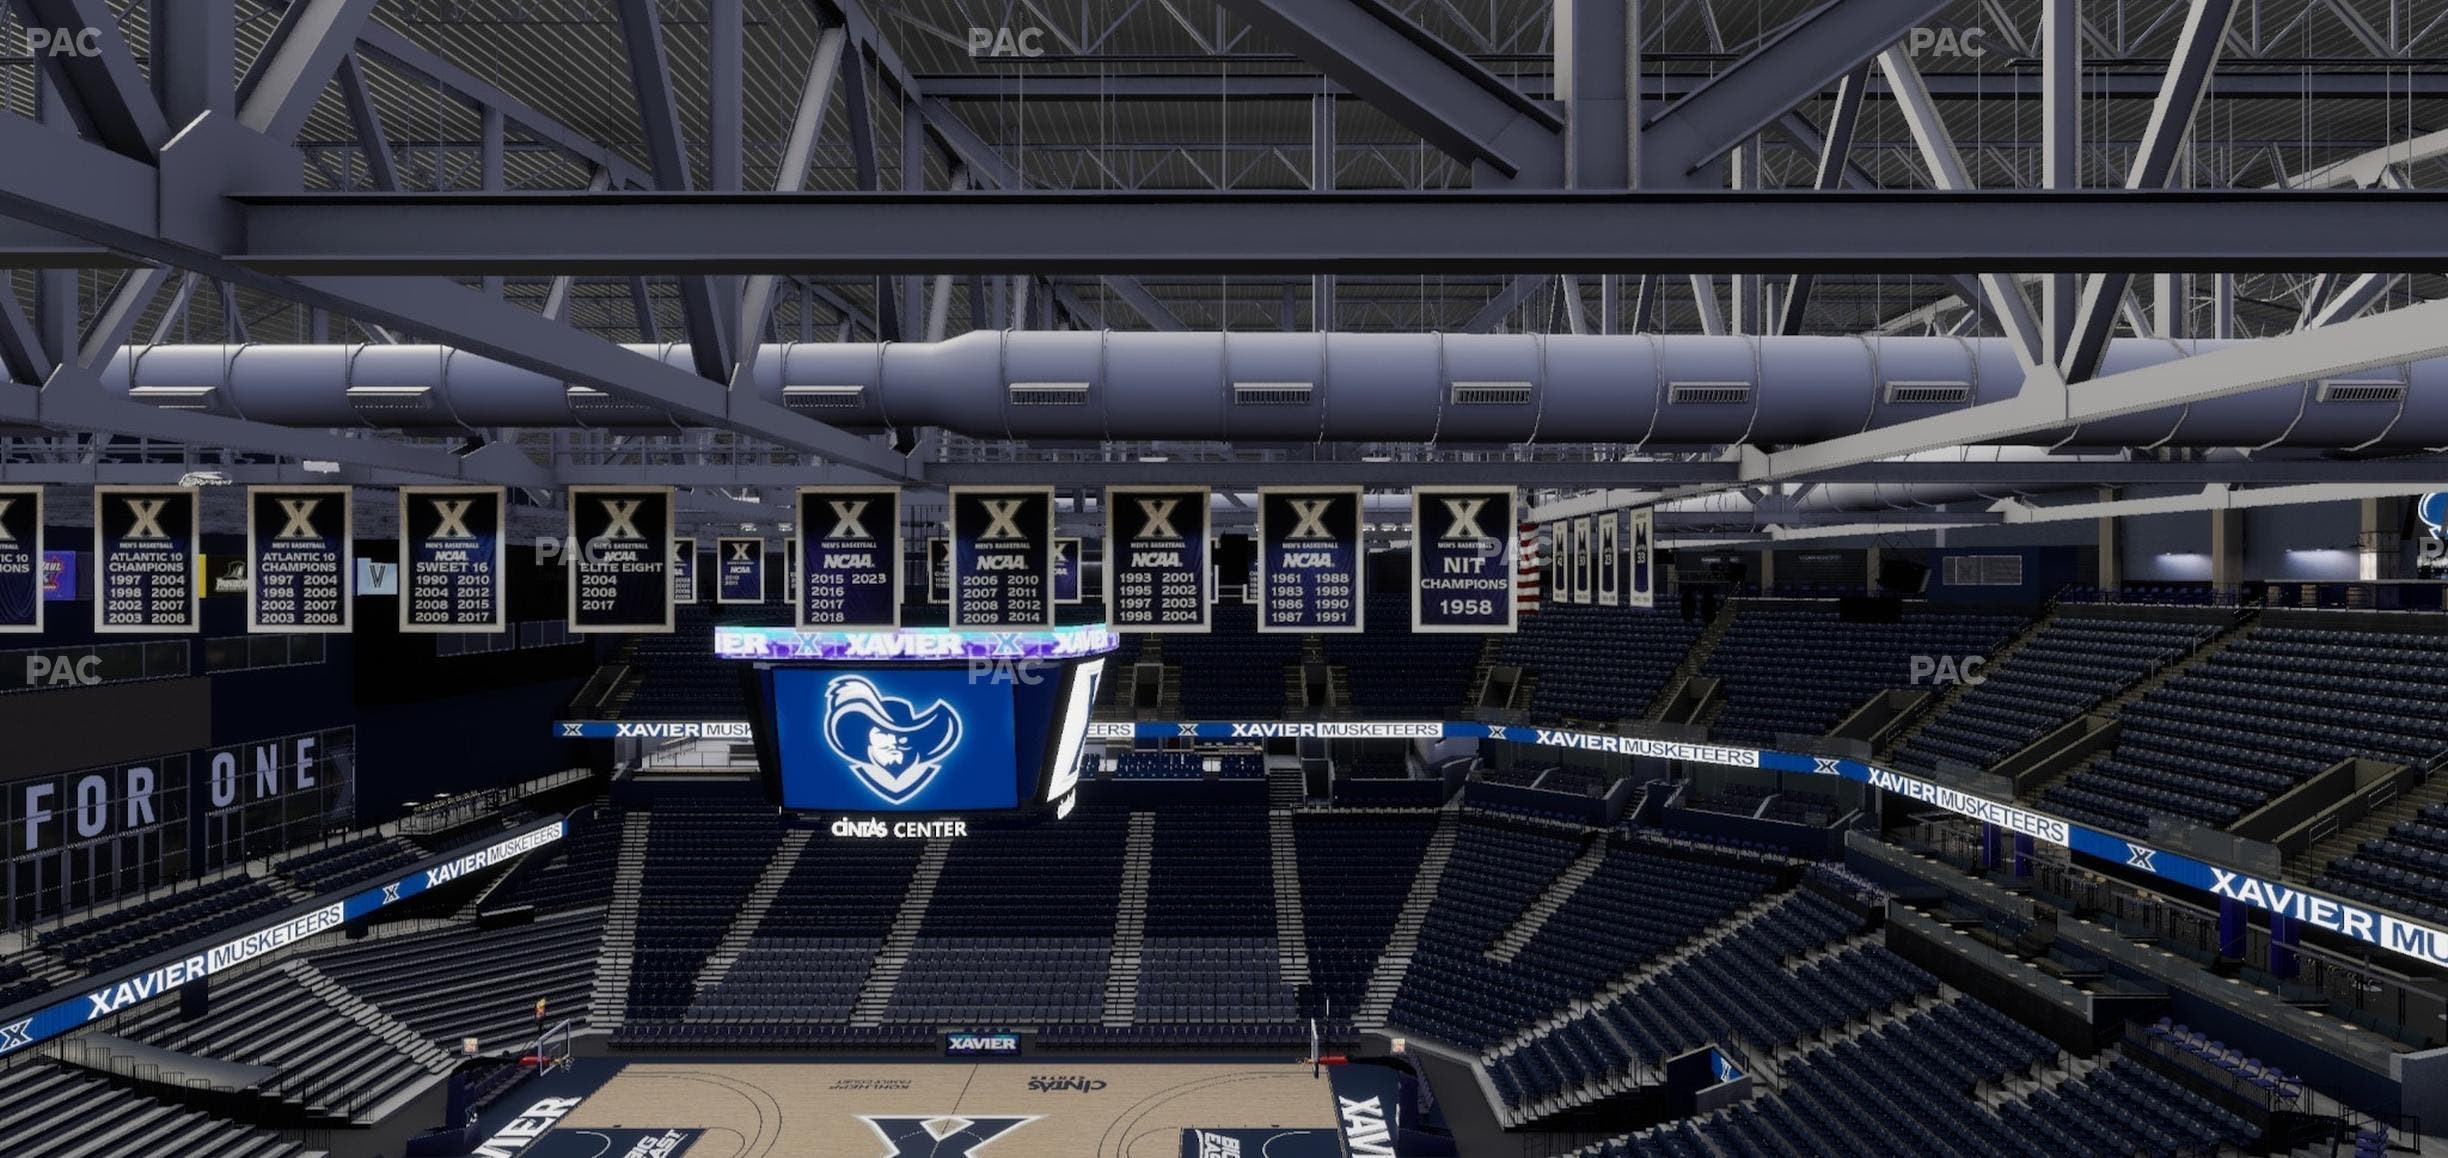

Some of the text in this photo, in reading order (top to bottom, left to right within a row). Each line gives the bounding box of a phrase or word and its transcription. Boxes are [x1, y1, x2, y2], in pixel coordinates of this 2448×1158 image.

[123, 500, 169, 539] X
[275, 500, 322, 539] X
[428, 501, 476, 540] X
[597, 501, 645, 540] X
[825, 502, 869, 539] X
[978, 500, 1022, 539] X
[1135, 500, 1182, 539] X
[1287, 500, 1334, 539] X
[1440, 500, 1491, 539] X
[16, 554, 28, 562] 10
[110, 553, 183, 561] ATLANTIC 10
[263, 553, 335, 561] ATLANTIC 10
[435, 551, 468, 563] NCAA
[602, 551, 637, 563] NCAA
[109, 563, 183, 572] CHAMPIONS
[262, 563, 336, 572] CHAMPIONS
[417, 562, 488, 572] SWEET 16
[579, 561, 619, 572] ELITE
[623, 563, 663, 572] EIGHT
[1444, 558, 1485, 573] NIT
[111, 575, 184, 585] 1997 2004
[263, 575, 337, 585] 1997 2004
[417, 575, 489, 585] 1990 2010
[583, 575, 617, 585] 2004
[812, 574, 886, 584] 2015 2023
[963, 575, 1039, 585] 2006 2010
[1120, 573, 1193, 583] 1993 2001
[1272, 573, 1349, 583] 1961 1988
[1419, 579, 1509, 590] CHAMPIONS
[111, 588, 184, 597] 1998 2006
[263, 588, 337, 597] 1998 2006
[415, 588, 489, 597] 2004 2012
[582, 588, 616, 597] 2008
[812, 586, 844, 596] 2016
[963, 587, 1036, 598] 2007 2011
[1120, 585, 1196, 595] 1995 2002
[1272, 586, 1349, 596] 1983 1989
[109, 600, 184, 610] 2002 2007
[262, 600, 336, 610] 2002 2007
[416, 599, 489, 609] 2008 2015
[583, 600, 614, 610] 2017
[812, 599, 844, 609] 2017
[963, 600, 1040, 611] 2008 2012
[1120, 598, 1197, 608] 1997 2003
[1272, 599, 1349, 609] 1986 1990
[1441, 600, 1492, 614] 1958
[109, 613, 185, 623] 2003 2008
[262, 613, 337, 623] 2003 2008
[416, 612, 489, 622] 2009 2017
[812, 612, 844, 622] 2018
[964, 612, 1040, 623] 2009 2014
[1120, 611, 1197, 621] 1998 2004
[1272, 612, 1346, 622] 1987 1991
[846, 633, 964, 655] XAVIER
[616, 724, 699, 736] XAVIER
[1231, 724, 1315, 736] XAVIER
[1322, 724, 1438, 735] MUSKETEERS
[1536, 731, 1618, 752] XAVIER
[1624, 740, 1755, 766] MUSKETEERS
[26, 737, 315, 850] FOR ONE
[1868, 768, 1936, 801] XAVIER
[1941, 790, 2065, 841] MUSKETEERS
[894, 821, 968, 836] CENTER
[426, 852, 486, 888] XAVIER
[491, 823, 560, 861] MUSKETEERS
[2210, 867, 2375, 942] XAVIER
[88, 957, 206, 1019] XAVIER
[214, 907, 341, 970] MUSKETEERS
[948, 1038, 1016, 1050] XAVIER
